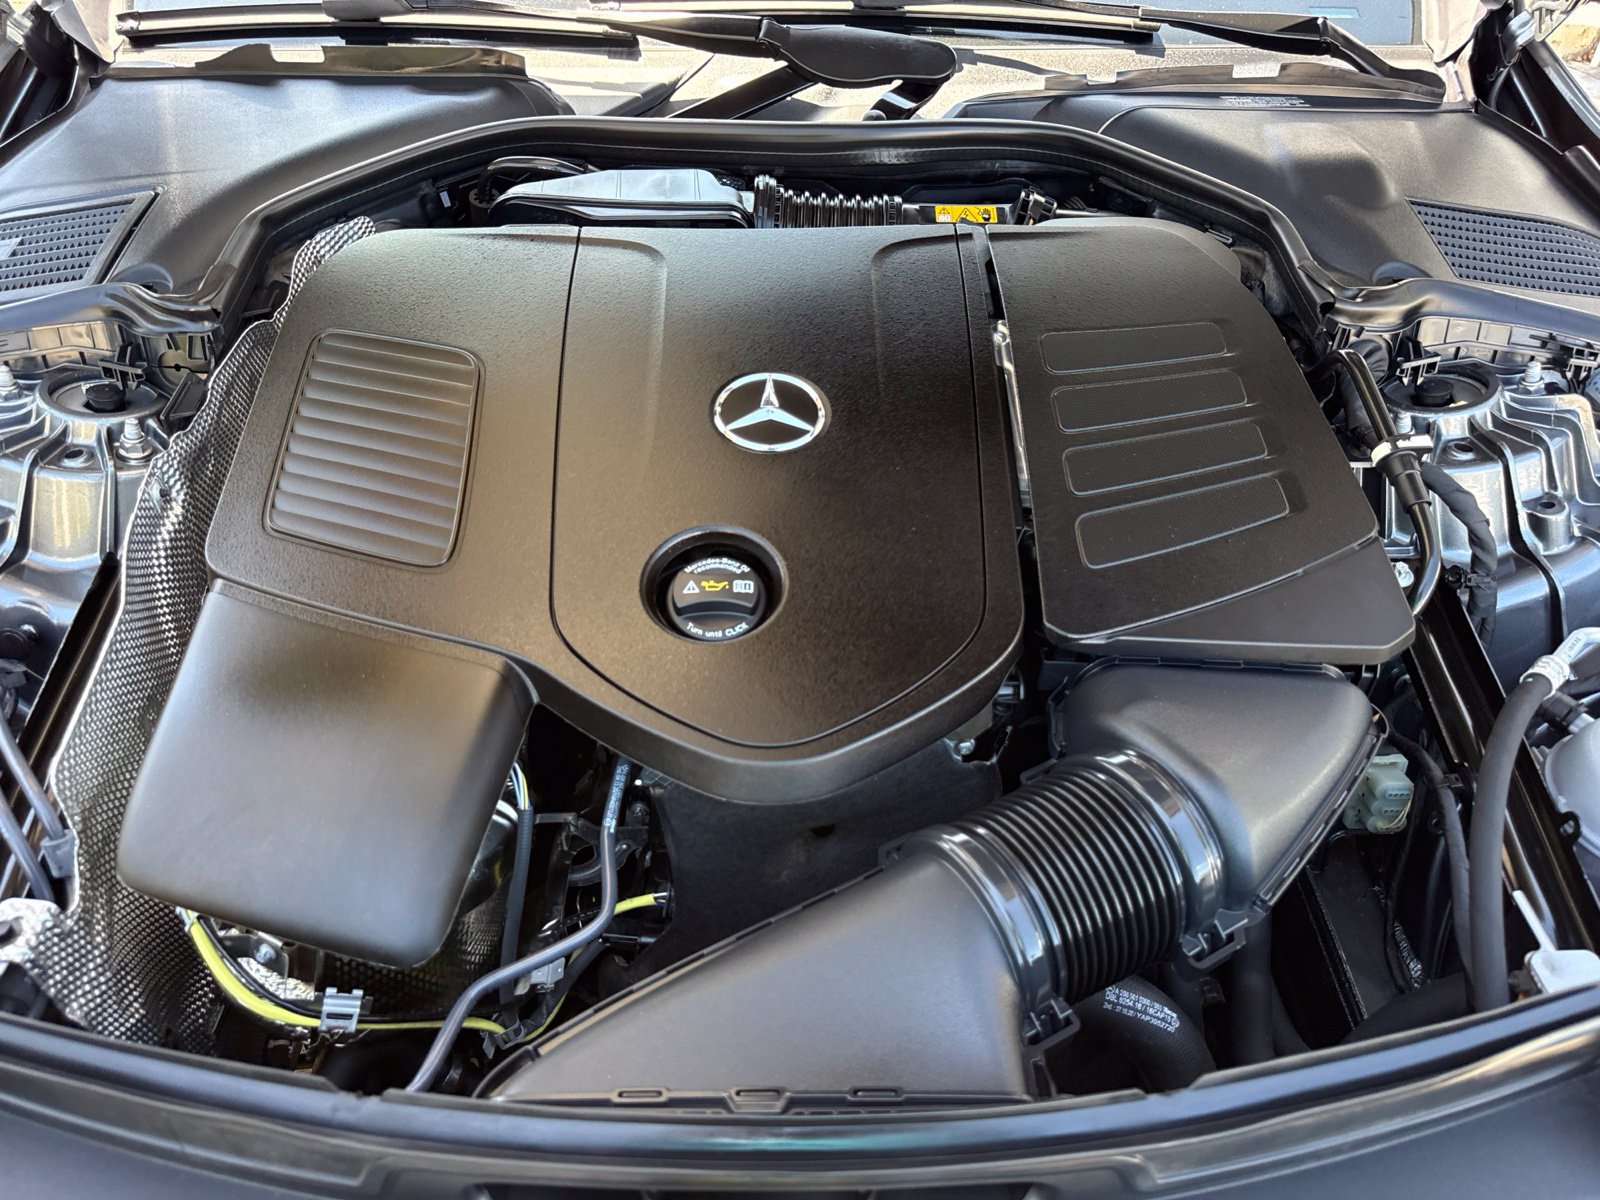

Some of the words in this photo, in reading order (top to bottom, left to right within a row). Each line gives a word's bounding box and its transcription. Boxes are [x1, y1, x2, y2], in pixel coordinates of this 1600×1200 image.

[684, 557, 740, 573] Mercedes-Benz
[693, 563, 742, 574] recommended
[686, 622, 703, 636] Turn
[705, 629, 723, 638] until
[725, 621, 749, 636] CLICK
